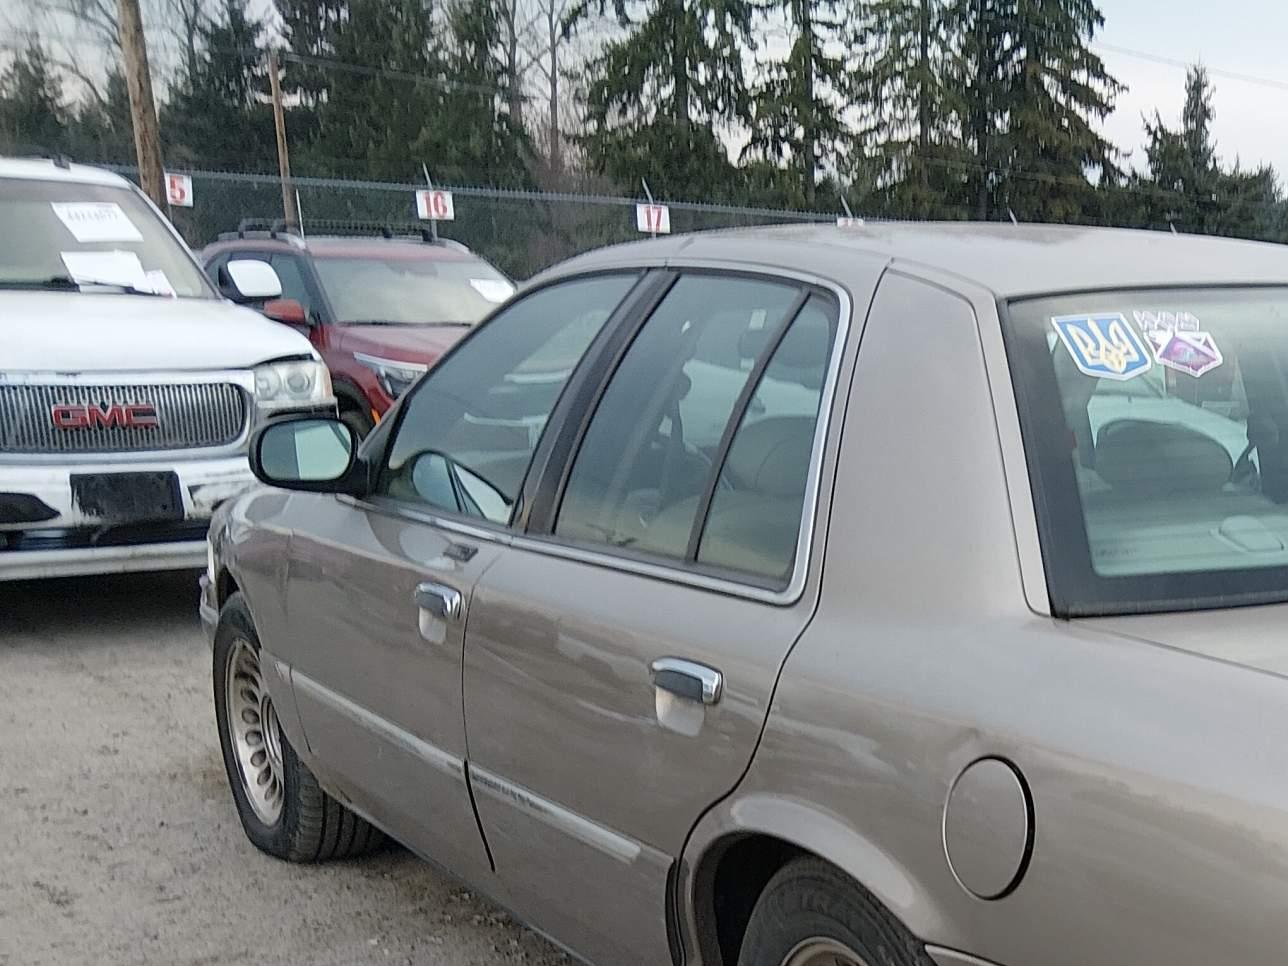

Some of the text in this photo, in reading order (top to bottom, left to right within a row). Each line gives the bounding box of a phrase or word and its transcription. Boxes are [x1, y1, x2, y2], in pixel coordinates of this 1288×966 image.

[423, 191, 448, 218] 16
[644, 206, 663, 232] 17
[52, 405, 157, 428] GMC
